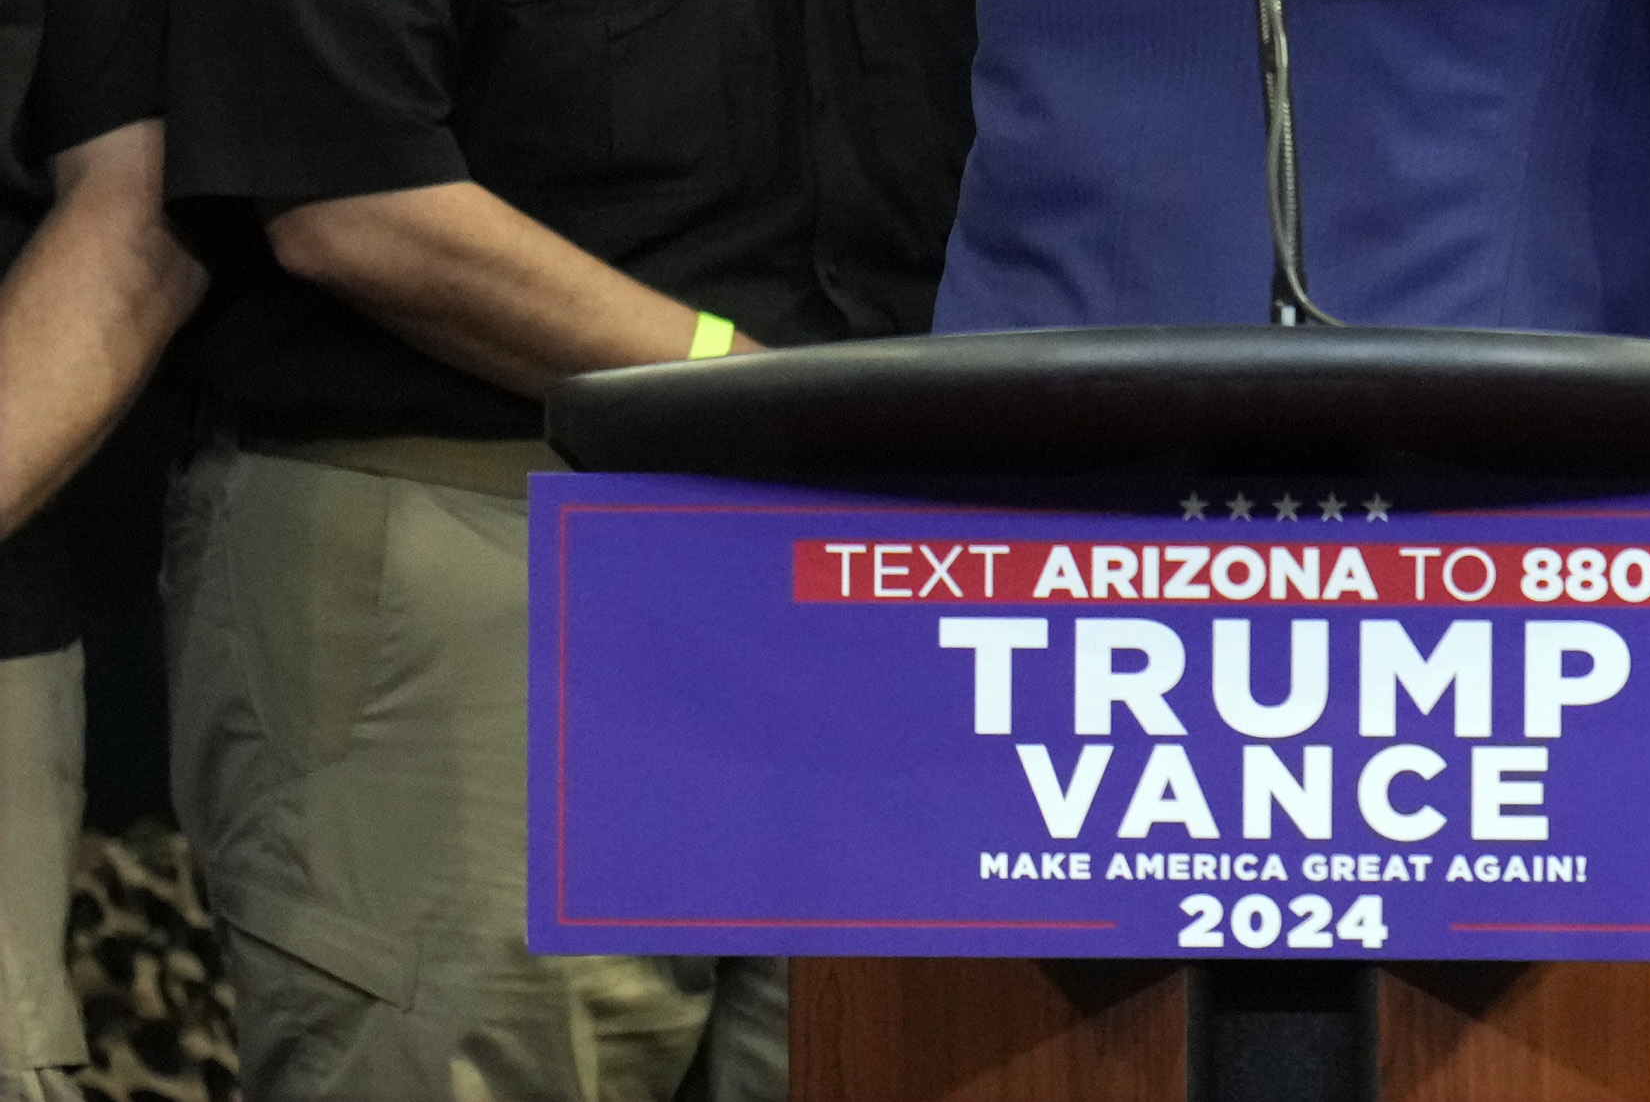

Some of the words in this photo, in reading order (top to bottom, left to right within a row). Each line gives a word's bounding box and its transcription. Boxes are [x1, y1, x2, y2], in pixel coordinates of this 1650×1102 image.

[826, 544, 1011, 599] TEXT
[1033, 545, 1380, 601] ARIZONA
[1400, 547, 1498, 603] TO
[939, 617, 1632, 740] TRUMP
[1016, 744, 1550, 843] VANCE
[980, 852, 1093, 881] MAKE
[1106, 853, 1290, 883] AMERICA
[1302, 854, 1434, 884] GREAT
[1446, 855, 1589, 884] AGAIN!
[1178, 894, 1390, 950] 2024
